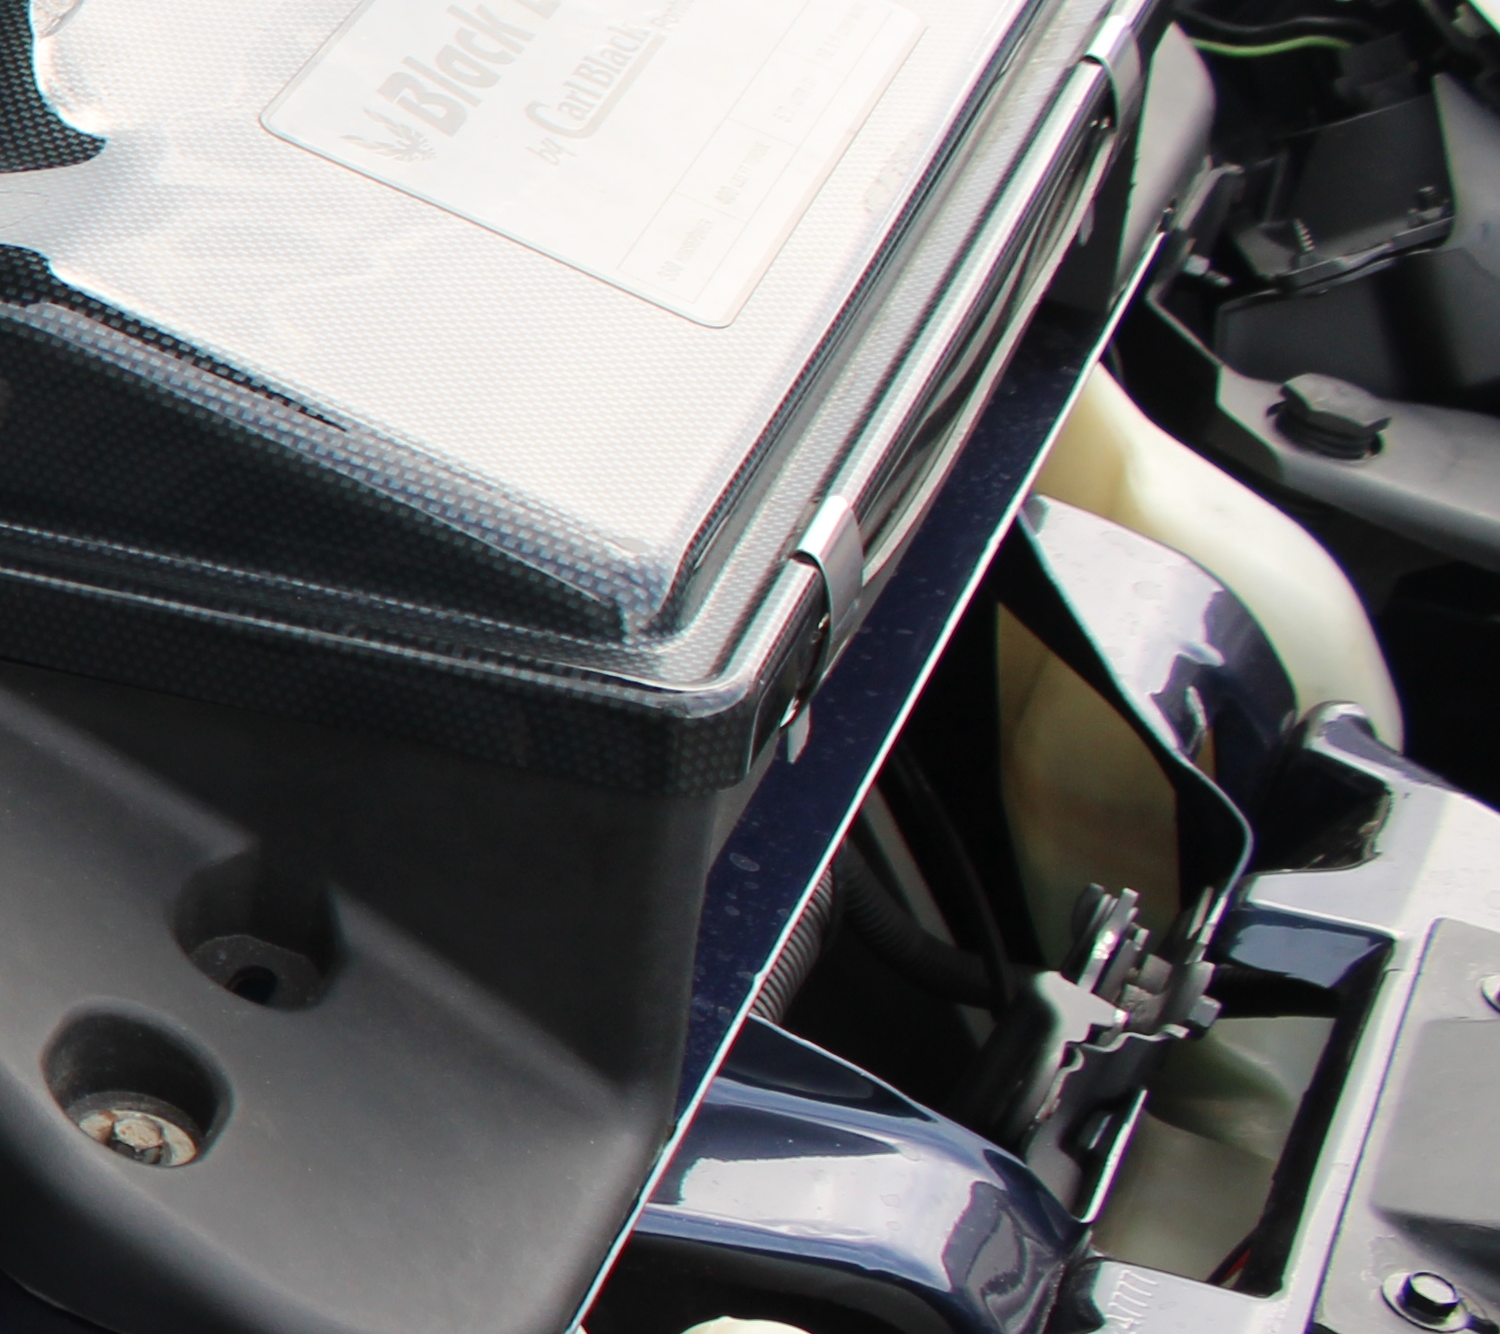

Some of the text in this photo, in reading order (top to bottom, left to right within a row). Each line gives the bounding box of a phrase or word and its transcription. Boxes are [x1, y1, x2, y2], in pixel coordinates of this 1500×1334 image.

[375, 3, 536, 137] Black
[572, 21, 650, 96] Black
[524, 78, 595, 138] Carl
[525, 137, 577, 165] by
